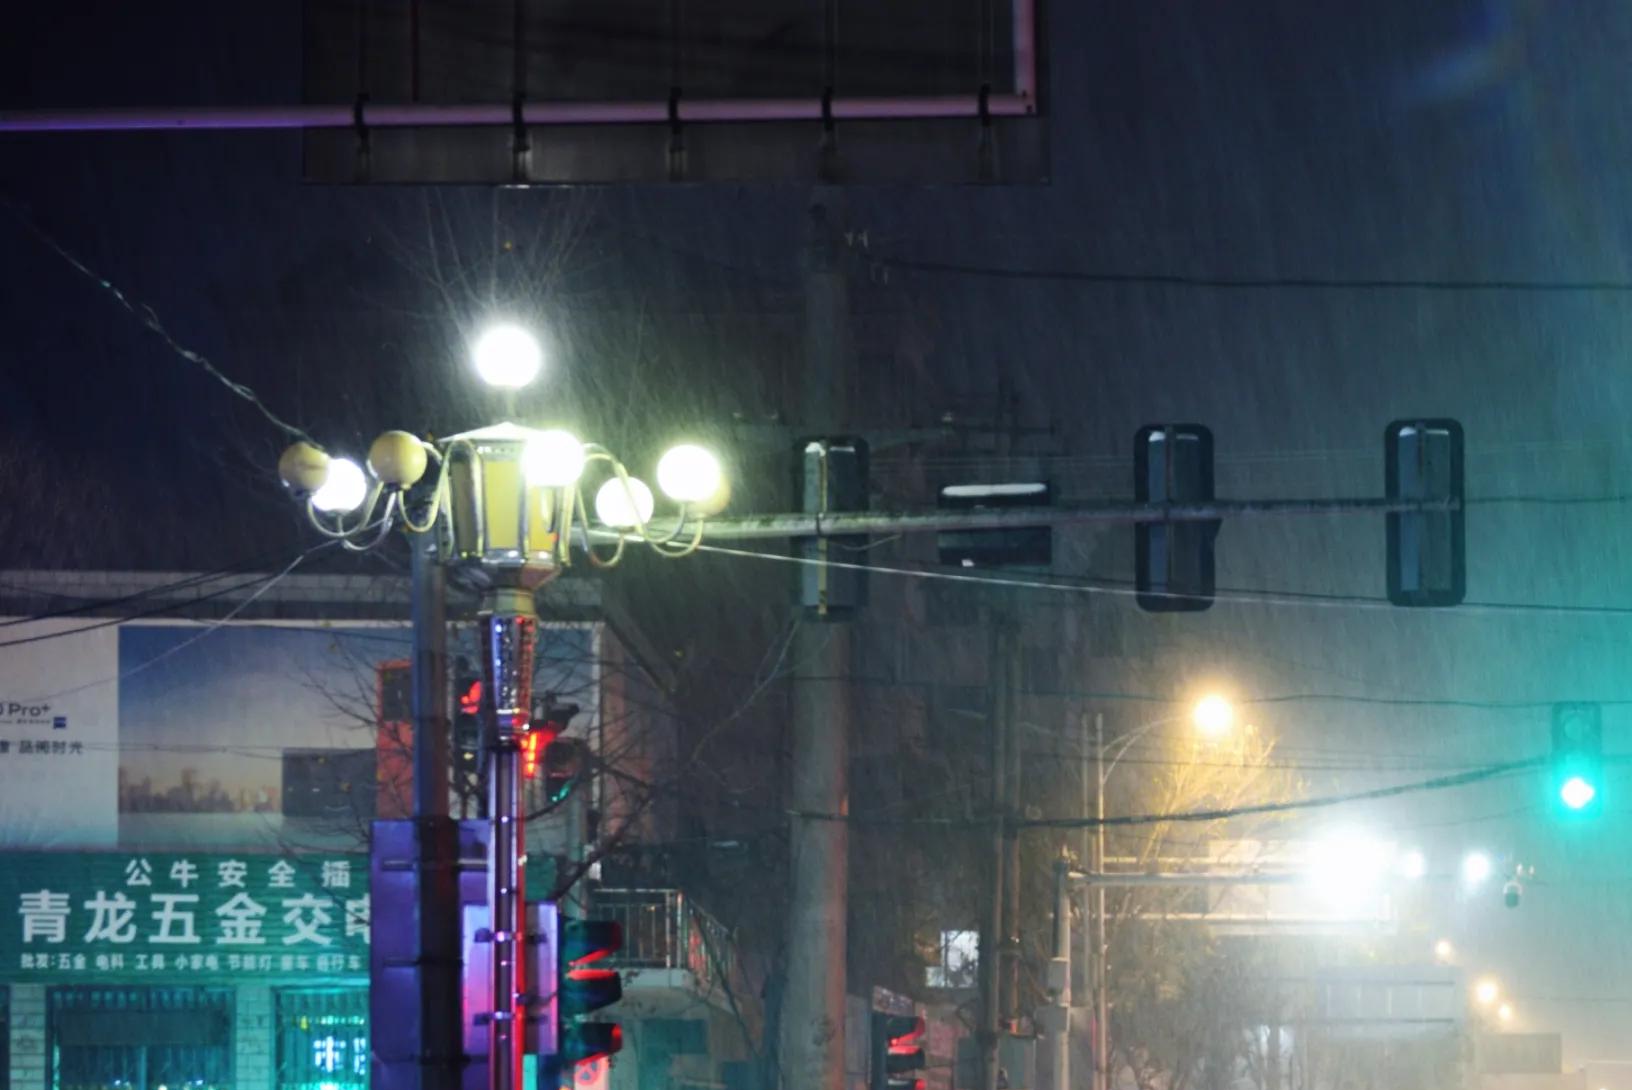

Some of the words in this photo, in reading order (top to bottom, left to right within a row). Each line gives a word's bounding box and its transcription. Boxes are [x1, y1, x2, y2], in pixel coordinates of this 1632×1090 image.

[125, 858, 350, 888] 公牛安全插
